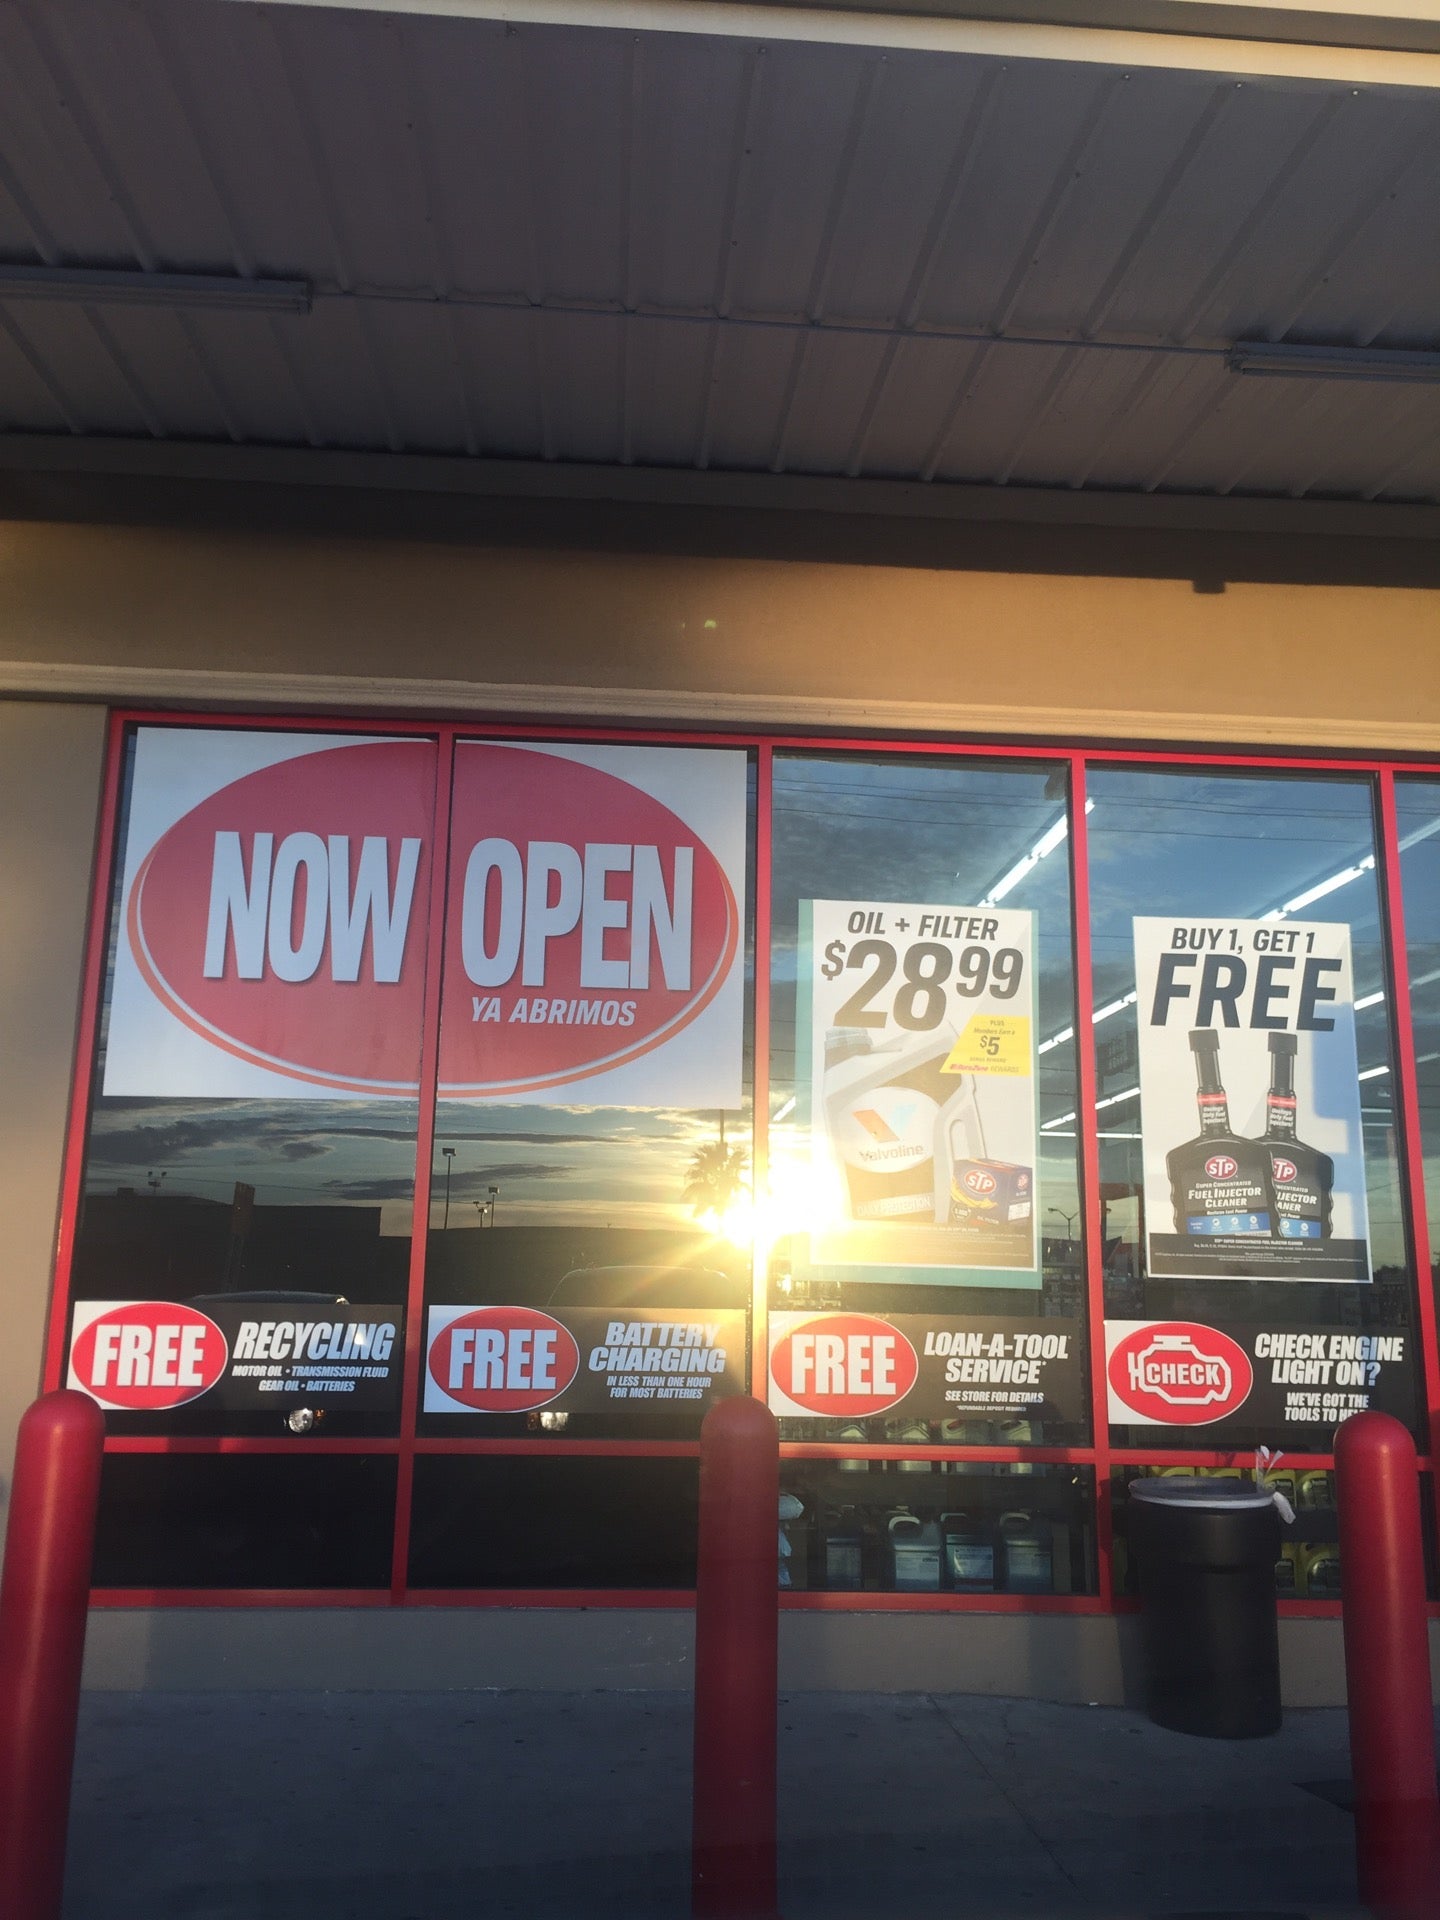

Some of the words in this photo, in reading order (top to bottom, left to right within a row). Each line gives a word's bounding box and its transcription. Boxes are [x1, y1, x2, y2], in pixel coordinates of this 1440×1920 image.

[203, 831, 422, 983] NOW
[461, 838, 694, 991] OPEN
[847, 910, 886, 935] OIL
[895, 918, 910, 932] +
[917, 915, 999, 941] FILTER
[1171, 927, 1223, 951] BUY
[1230, 929, 1244, 954] 1,
[1253, 930, 1302, 954] GET
[1305, 931, 1315, 953] 1
[1150, 953, 1342, 1032] FREE
[471, 997, 502, 1023] YA
[509, 998, 637, 1027] ABRIMOS
[980, 1035, 1000, 1055] $5
[859, 1144, 924, 1161] Valvoline
[1209, 1158, 1234, 1176] STP
[967, 1173, 993, 1190] STP
[1188, 1189, 1214, 1200] FUEL
[1214, 1187, 1261, 1199] INJECTOR
[1205, 1198, 1248, 1208] CLEANER
[1278, 1202, 1302, 1212] ANER
[232, 1321, 396, 1361] RECYCLING
[605, 1322, 721, 1347] BATTERY
[91, 1325, 207, 1387] FREE
[1254, 1332, 1328, 1360] CHECK
[1329, 1335, 1404, 1362] ENGINE
[449, 1328, 557, 1390] FREE
[588, 1347, 727, 1373] CHARGING
[791, 1333, 897, 1395] FREE
[232, 1365, 267, 1377] MOTOR
[268, 1366, 282, 1377] OIL
[292, 1366, 362, 1378] TRANSMISSION
[362, 1366, 388, 1378] FLUID
[607, 1375, 617, 1387] IN
[618, 1375, 639, 1387] LESS
[642, 1375, 664, 1387] THAN
[667, 1376, 685, 1387] ONE
[686, 1376, 712, 1387] HOUR
[1146, 1363, 1221, 1385] CHECK
[1271, 1360, 1334, 1385] LIGHT
[1336, 1361, 1381, 1387] ON?
[259, 1380, 283, 1391] GEAR
[284, 1380, 300, 1391] OIL
[306, 1380, 355, 1392] BATTERIES
[610, 1387, 628, 1398] FOR
[629, 1387, 656, 1399] MOST
[657, 1388, 703, 1399] BATTERIES
[945, 1390, 961, 1401] SEE
[962, 1390, 990, 1402] STORE
[991, 1391, 1008, 1402] FOR
[1009, 1392, 1044, 1403] DETAILS
[1286, 1392, 1321, 1407] WE'VE
[1322, 1393, 1346, 1407] GOT
[1347, 1394, 1370, 1408] THE
[1284, 1407, 1320, 1421] TOOLS
[1322, 1408, 1335, 1422] TO
[1339, 1408, 1366, 1422] HE
